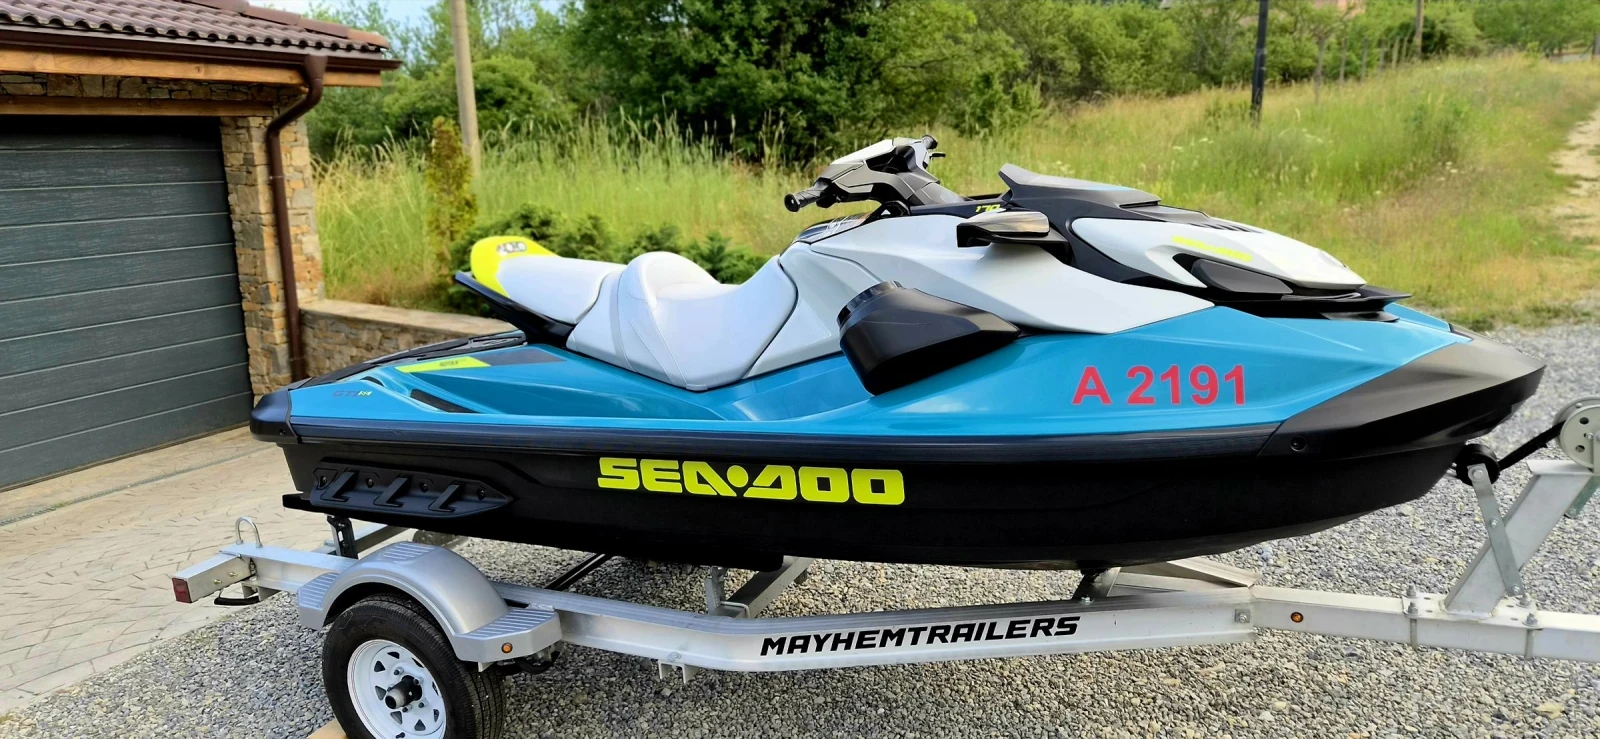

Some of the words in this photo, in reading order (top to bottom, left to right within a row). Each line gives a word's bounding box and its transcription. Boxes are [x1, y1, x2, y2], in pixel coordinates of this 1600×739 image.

[1072, 366, 1112, 405] A
[1126, 364, 1246, 405] 2191
[760, 616, 1081, 656] MAYHEMTRAILERS
